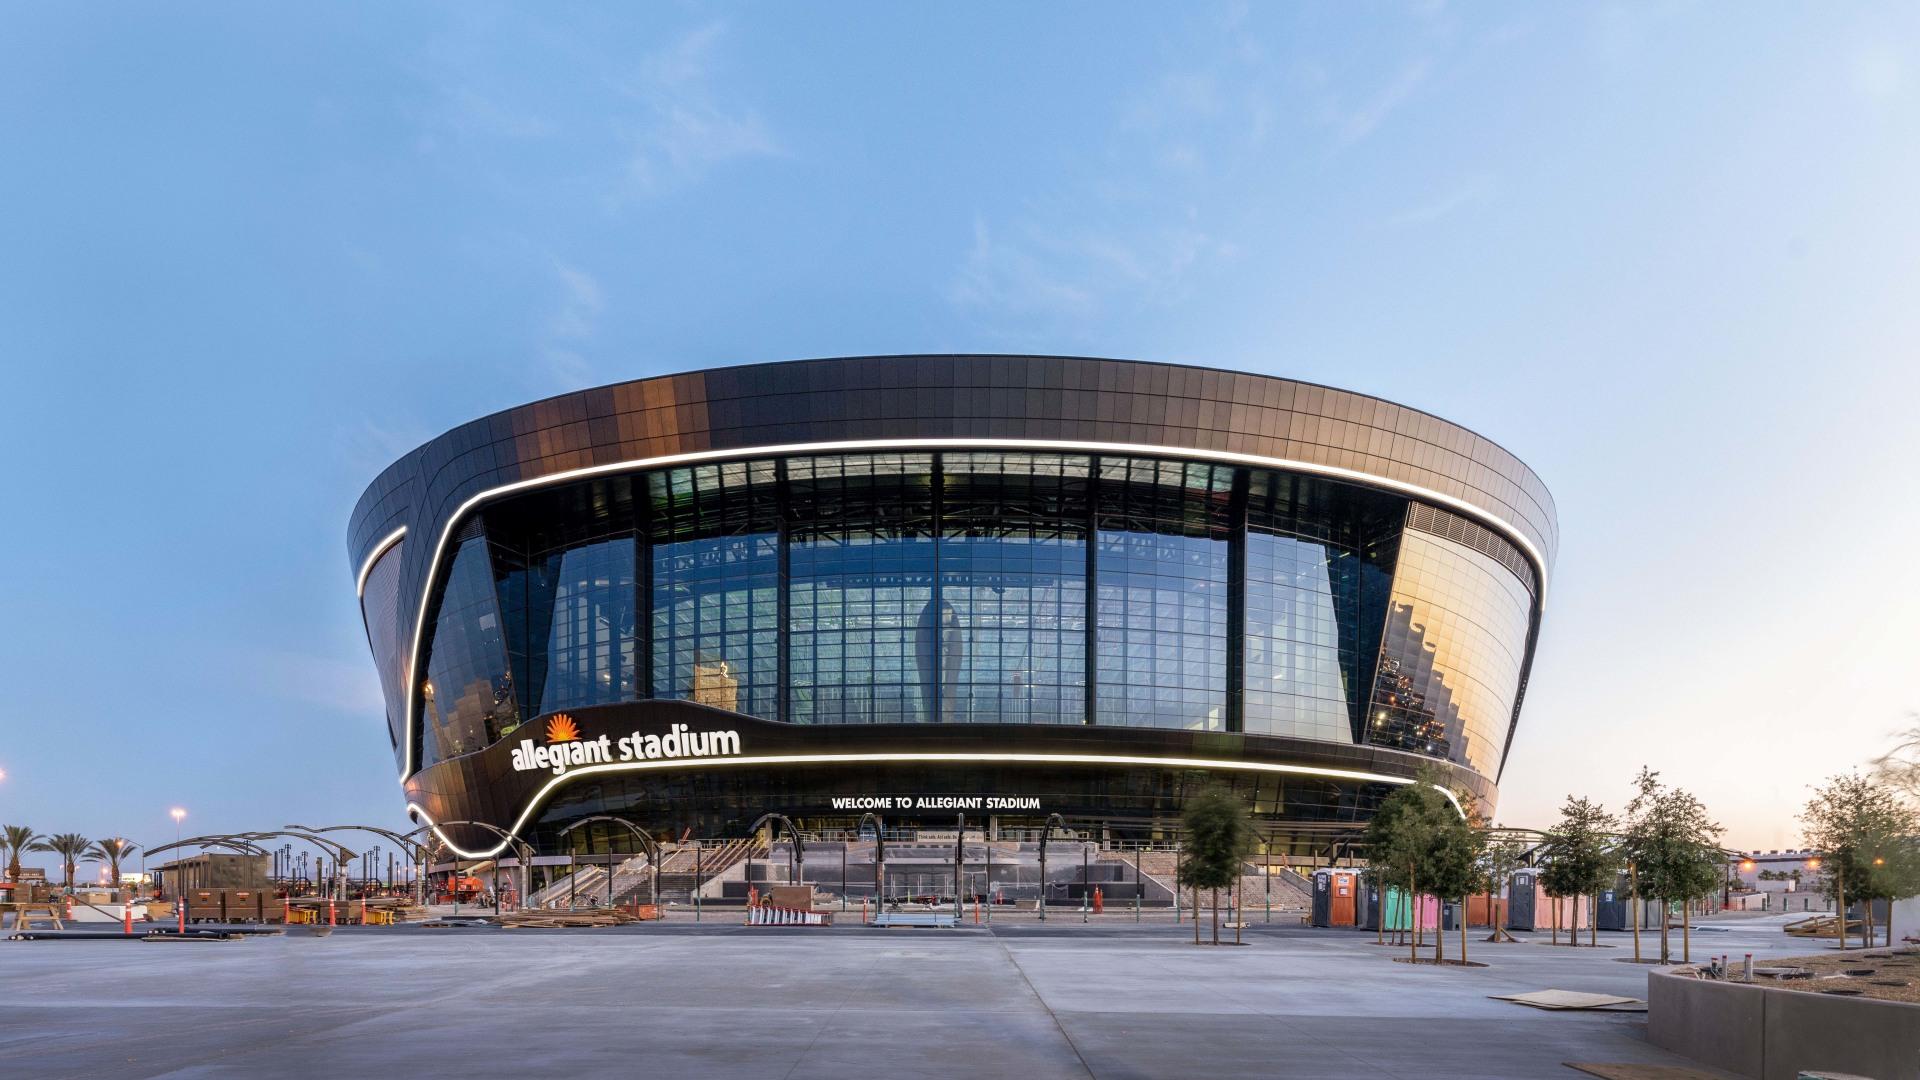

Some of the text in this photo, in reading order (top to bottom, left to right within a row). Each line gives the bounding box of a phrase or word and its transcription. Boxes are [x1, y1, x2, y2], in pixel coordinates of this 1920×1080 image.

[511, 723, 741, 775] allegiant stadium
[832, 797, 1041, 809] WELCOME TO ALLEGIANT STADIUM
